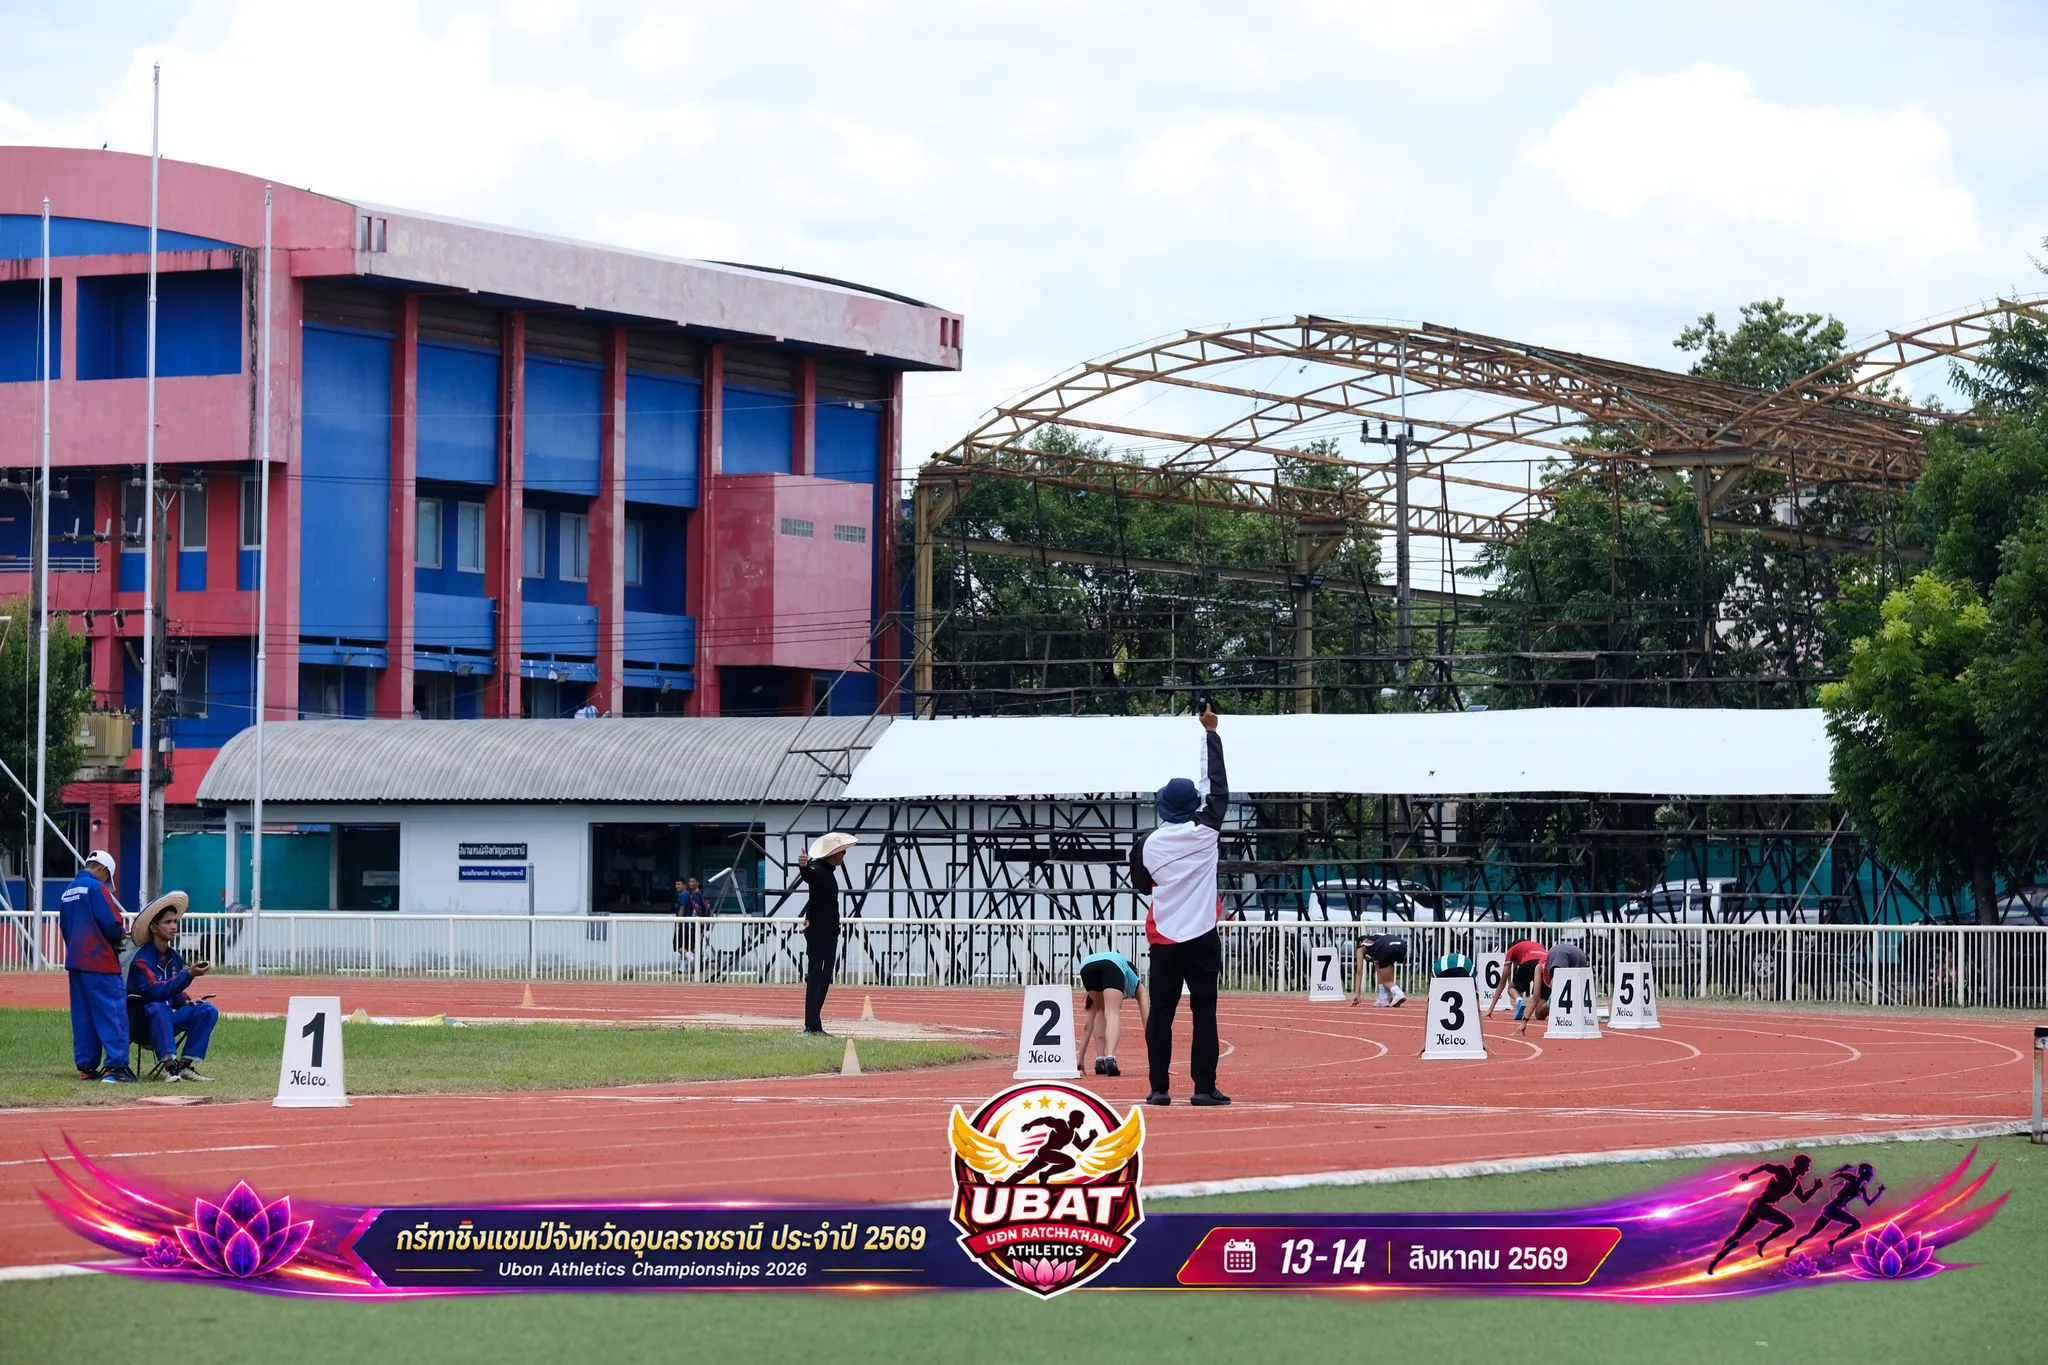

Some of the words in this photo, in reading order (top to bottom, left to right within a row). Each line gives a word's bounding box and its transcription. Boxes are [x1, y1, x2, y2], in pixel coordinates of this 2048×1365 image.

[1317, 955, 1332, 982] 7
[1485, 960, 1501, 989] 6
[1558, 979, 1573, 1014] 4
[1583, 978, 1592, 1014] 4
[1620, 973, 1635, 1005] 5
[1643, 972, 1651, 1005] 5
[1033, 1000, 1061, 1046] 2
[1440, 990, 1465, 1032] 3
[1554, 1016, 1573, 1027] Nelco
[1615, 1007, 1634, 1017] Nelco
[302, 1012, 326, 1068] 1
[1436, 1033, 1466, 1046] Nelco
[1028, 1050, 1062, 1064] Nelco
[290, 1069, 327, 1087] Nelco
